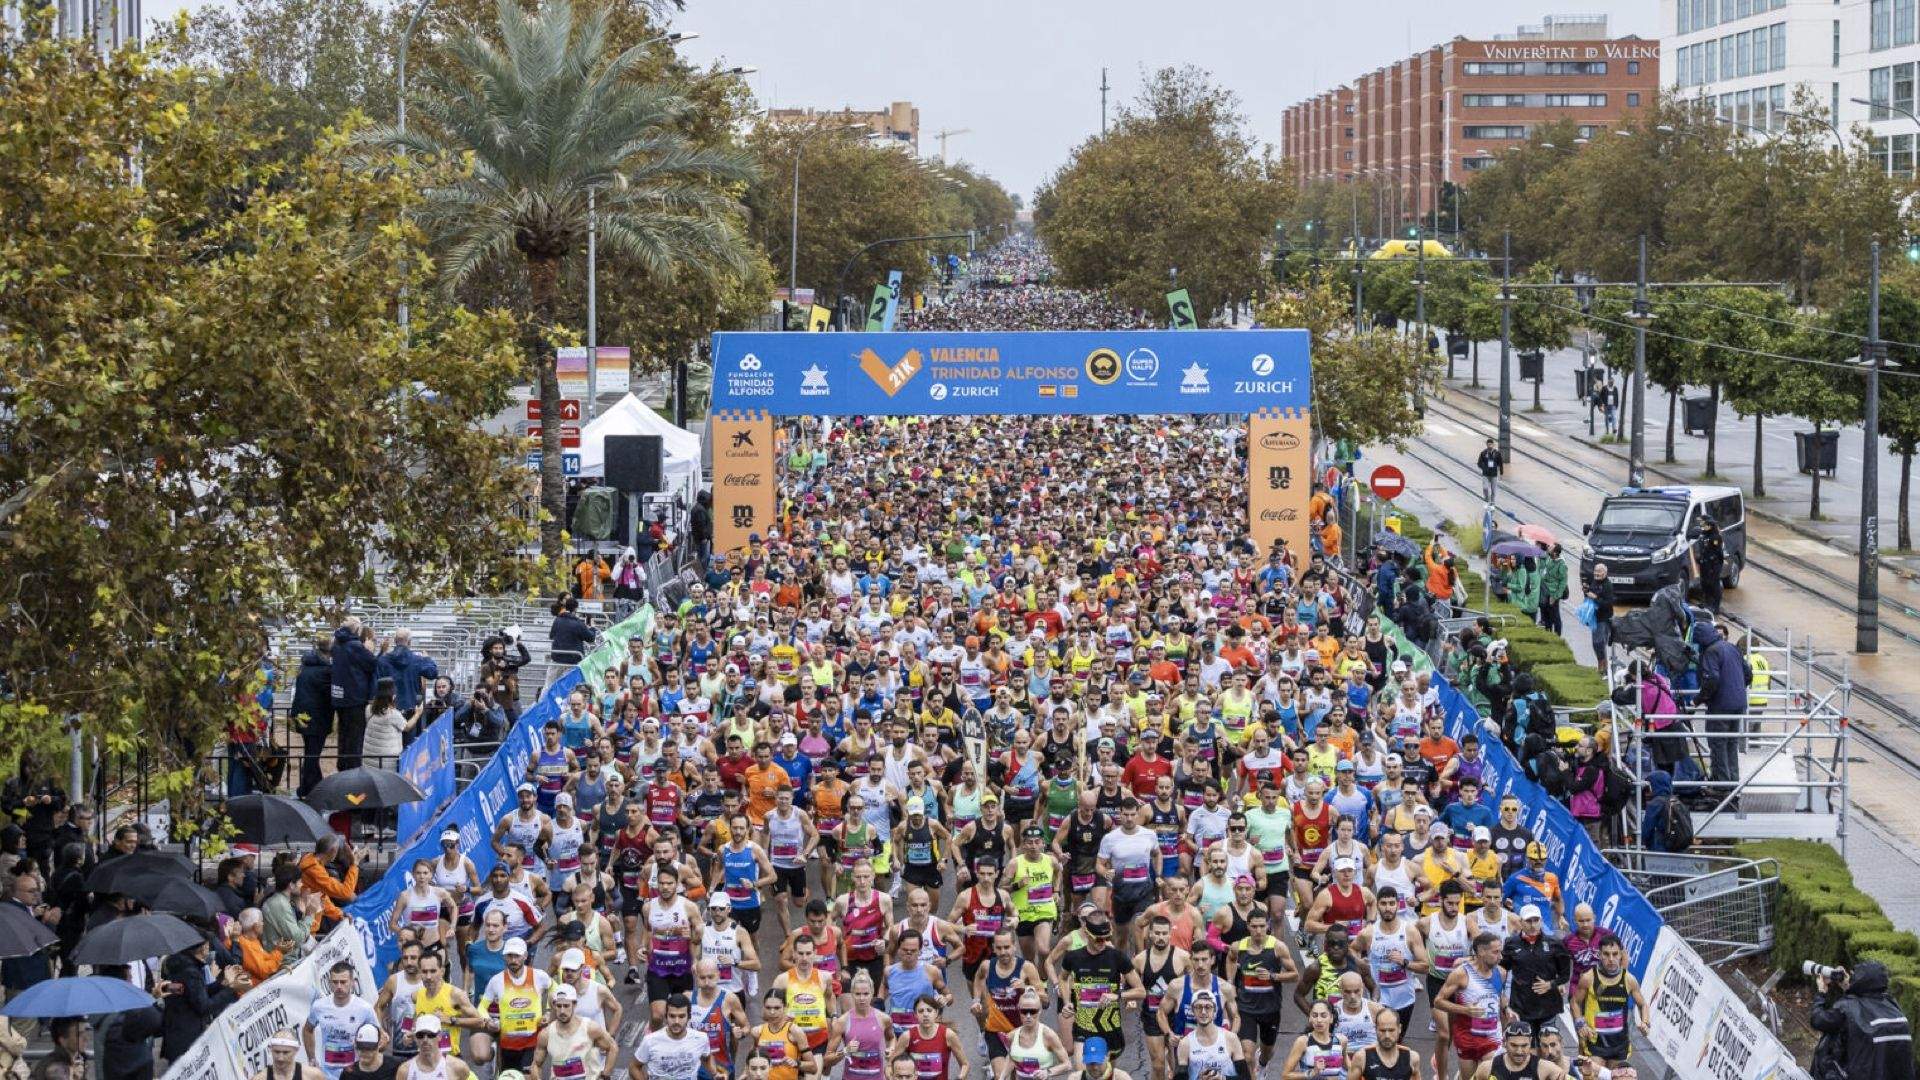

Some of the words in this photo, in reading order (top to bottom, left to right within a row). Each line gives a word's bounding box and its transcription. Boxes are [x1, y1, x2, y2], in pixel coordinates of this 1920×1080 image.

[890, 280, 900, 300] 3
[871, 297, 887, 323] 2
[930, 348, 999, 362] VALENCIA
[888, 358, 915, 388] 21K
[931, 367, 1000, 379] TRINIDAD
[1006, 367, 1079, 379] ALFONSO
[728, 388, 774, 396] ALFONSO
[952, 386, 999, 396] ZURICH
[1234, 381, 1293, 393] ZURICH
[565, 457, 578, 472] 14
